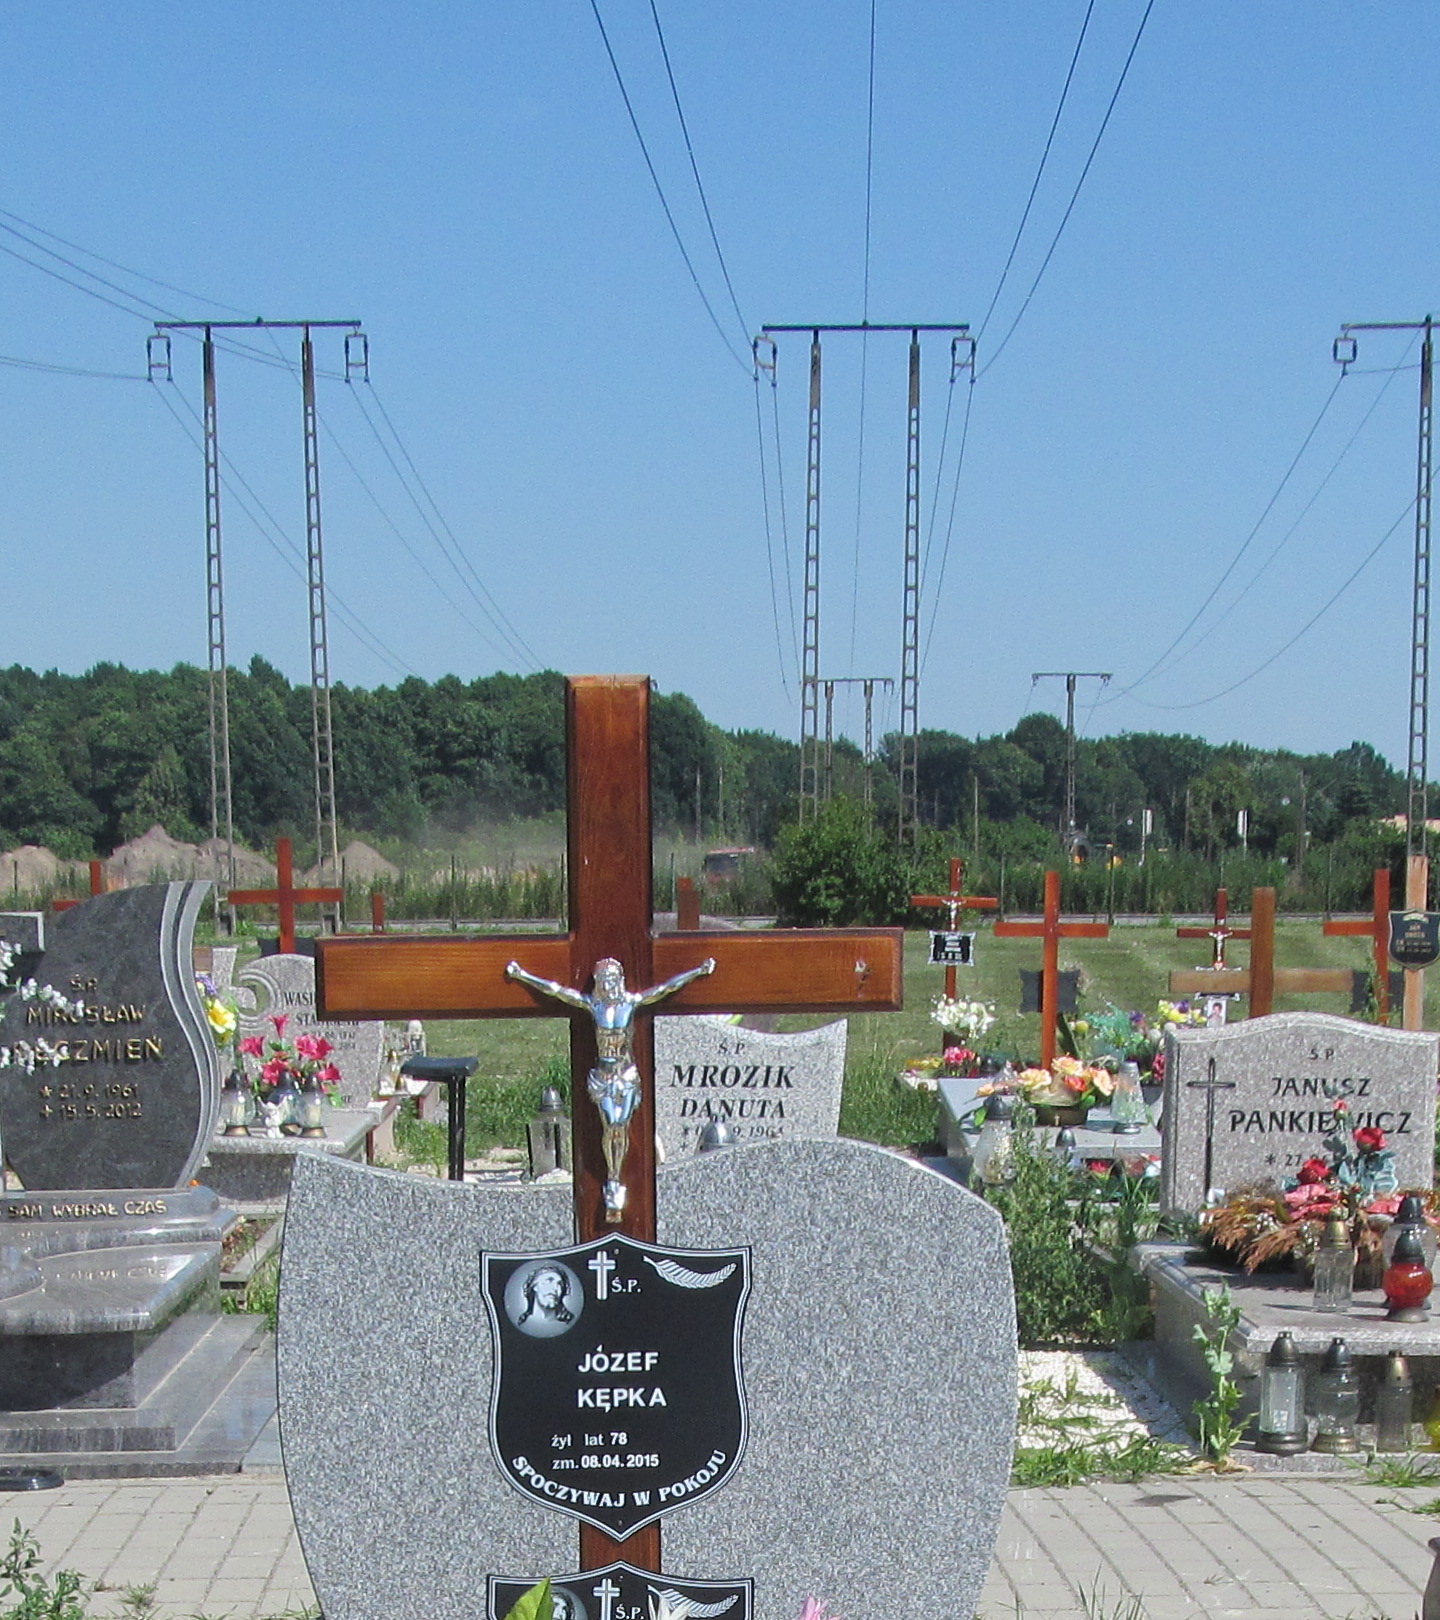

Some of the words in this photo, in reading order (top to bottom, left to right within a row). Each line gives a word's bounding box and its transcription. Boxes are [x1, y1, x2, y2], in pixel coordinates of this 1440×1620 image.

[27, 1004, 146, 1025] MIROSŁAW
[13, 1034, 163, 1063] ĘCZMIEŃ
[670, 1063, 796, 1089] MROZIK
[1271, 1076, 1372, 1098] JANUSZ
[680, 1098, 786, 1119] DANUTA
[9, 1204, 43, 1218] SAM
[52, 1203, 118, 1218] WYBRAŁ
[124, 1200, 168, 1216] CZAS
[611, 1276, 642, 1294] Ś.P.
[577, 1344, 660, 1374] JÓZEF
[576, 1387, 669, 1413] KĘPKA
[584, 1433, 605, 1447] lat
[610, 1432, 629, 1447] 78
[511, 1454, 626, 1508] SPOCZYWAJ
[633, 1491, 651, 1507] W
[658, 1448, 728, 1503] POKOJU
[615, 1603, 645, 1620] Ś.P.
